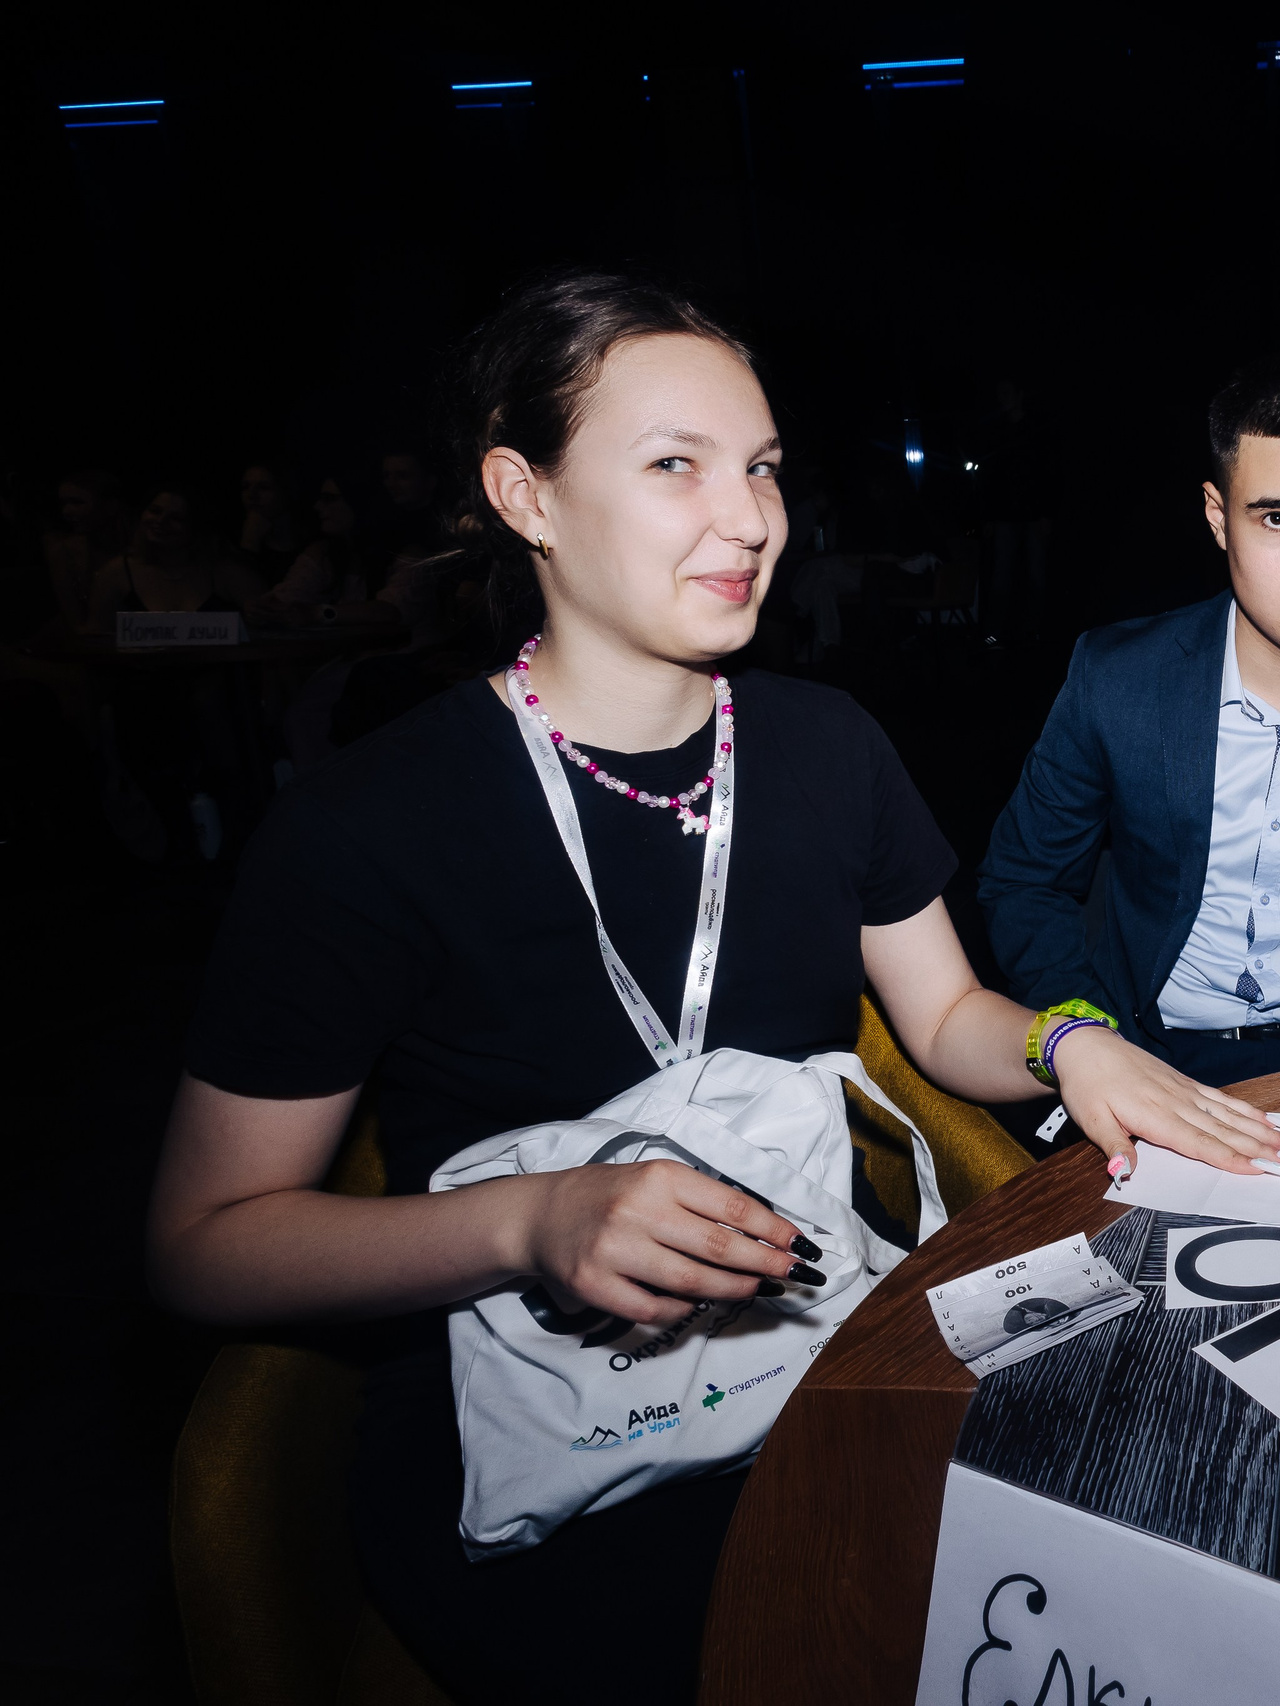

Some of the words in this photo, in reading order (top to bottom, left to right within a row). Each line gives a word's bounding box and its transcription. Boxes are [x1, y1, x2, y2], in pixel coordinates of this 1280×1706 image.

[122, 616, 178, 641] Компас
[187, 626, 229, 640] души
[994, 1260, 1028, 1280] 500
[1004, 1283, 1034, 1299] 100
[627, 1402, 681, 1431] Айда
[627, 1428, 644, 1442] на
[646, 1416, 681, 1436] Урал
